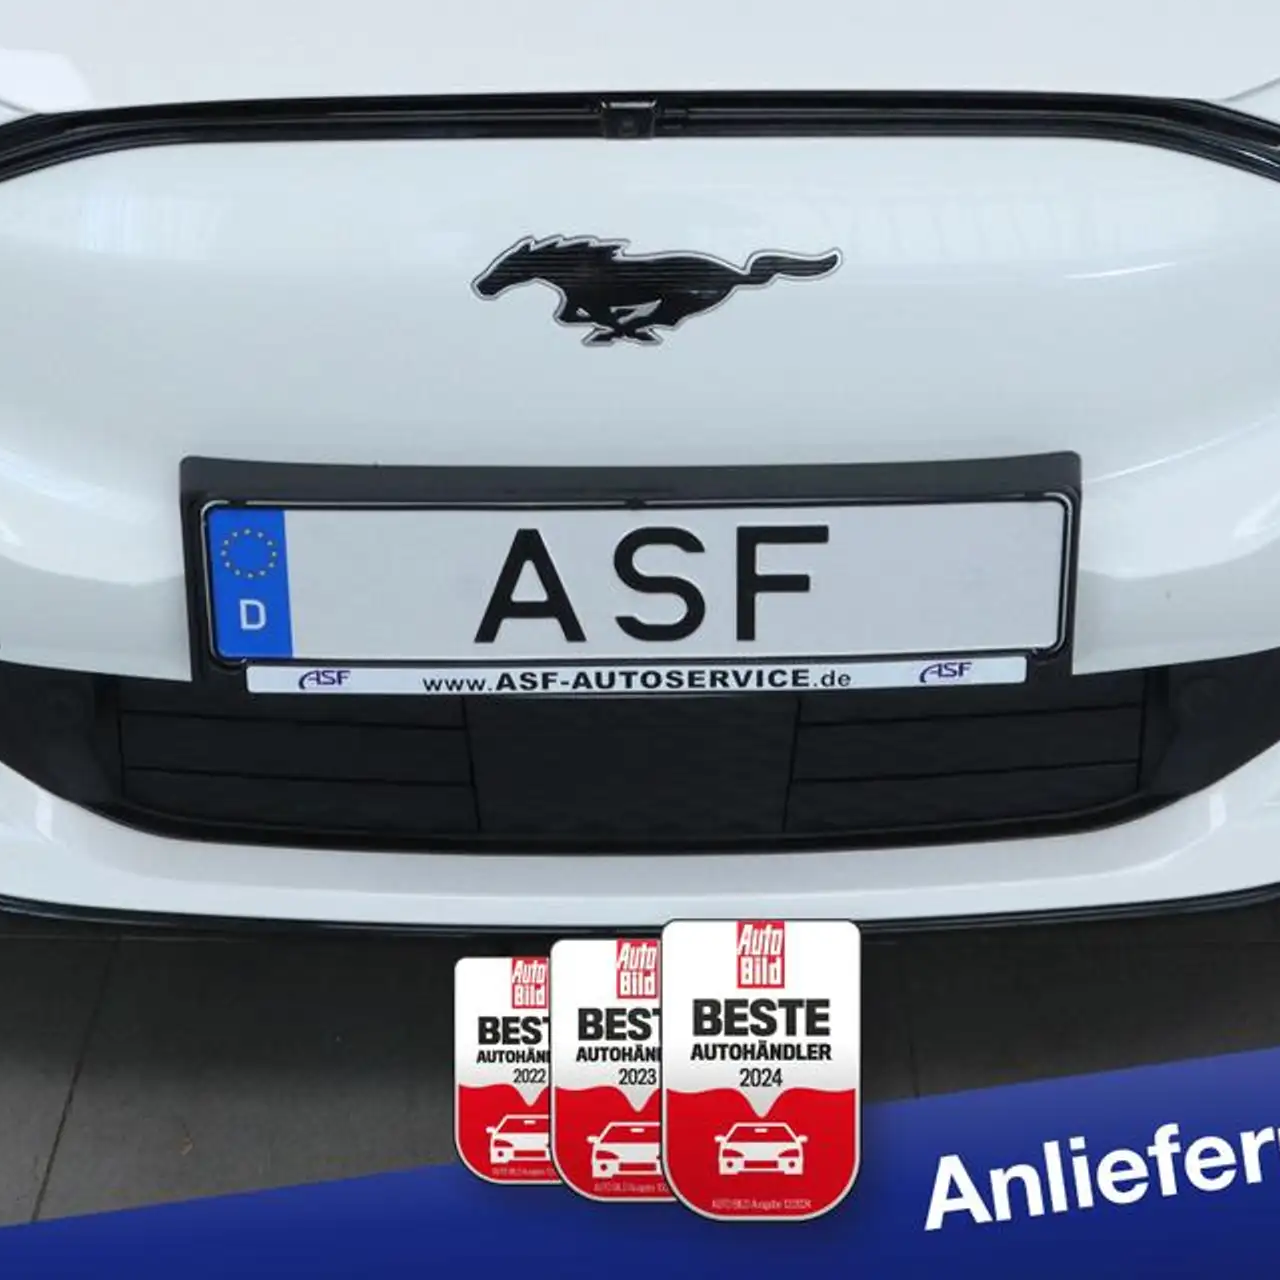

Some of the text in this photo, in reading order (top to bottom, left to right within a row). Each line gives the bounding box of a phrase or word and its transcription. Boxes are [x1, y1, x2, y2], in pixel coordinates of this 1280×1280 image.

[474, 525, 829, 644] ASF
[239, 599, 267, 630] D
[298, 669, 352, 691] ASF
[422, 668, 852, 693] www.ASF-AUTOSERVICE.de
[919, 662, 973, 684] ASF
